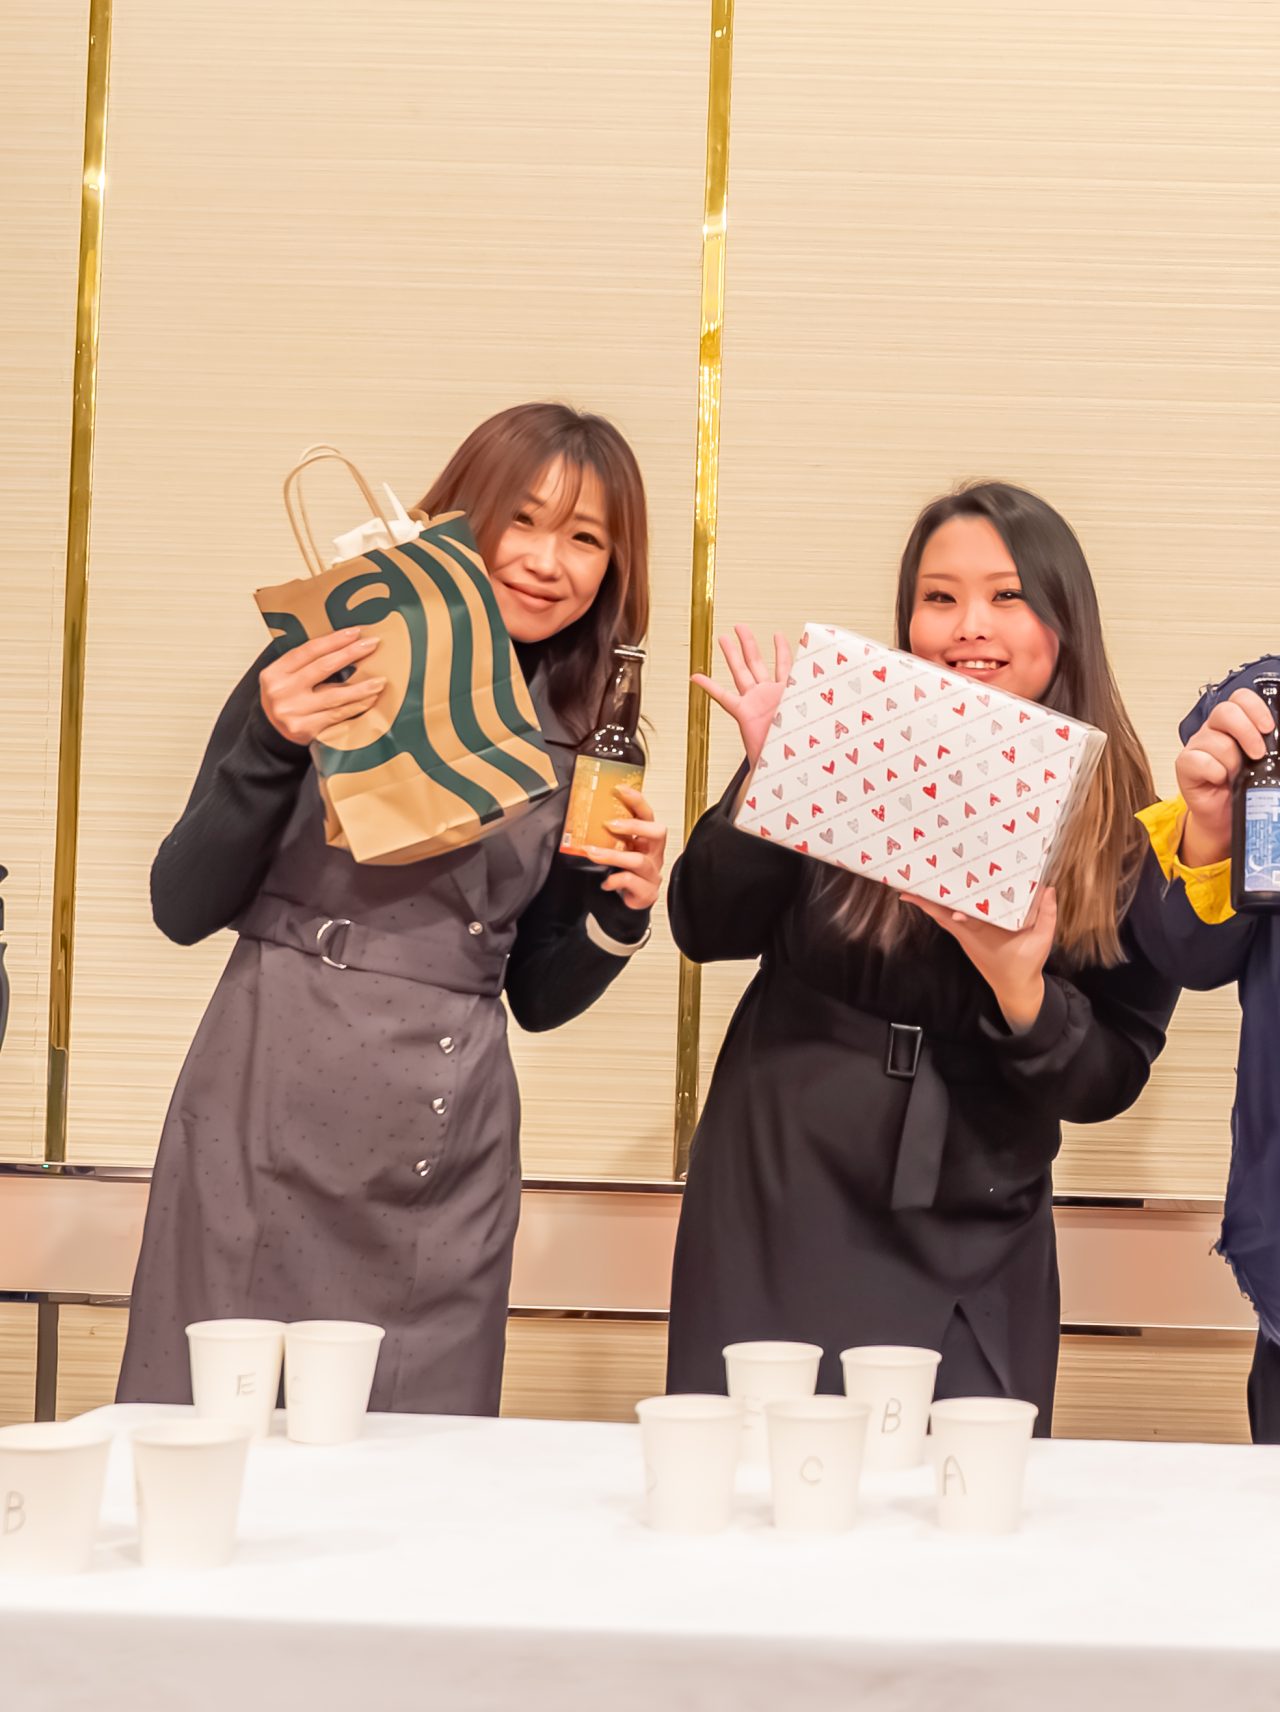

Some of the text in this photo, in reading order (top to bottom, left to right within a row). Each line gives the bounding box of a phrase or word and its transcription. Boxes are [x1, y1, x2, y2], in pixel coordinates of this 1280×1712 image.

[235, 1371, 257, 1398] E
[880, 1396, 903, 1435] B
[799, 1454, 825, 1487] C
[942, 1453, 968, 1497] A
[2, 1489, 27, 1536] B
